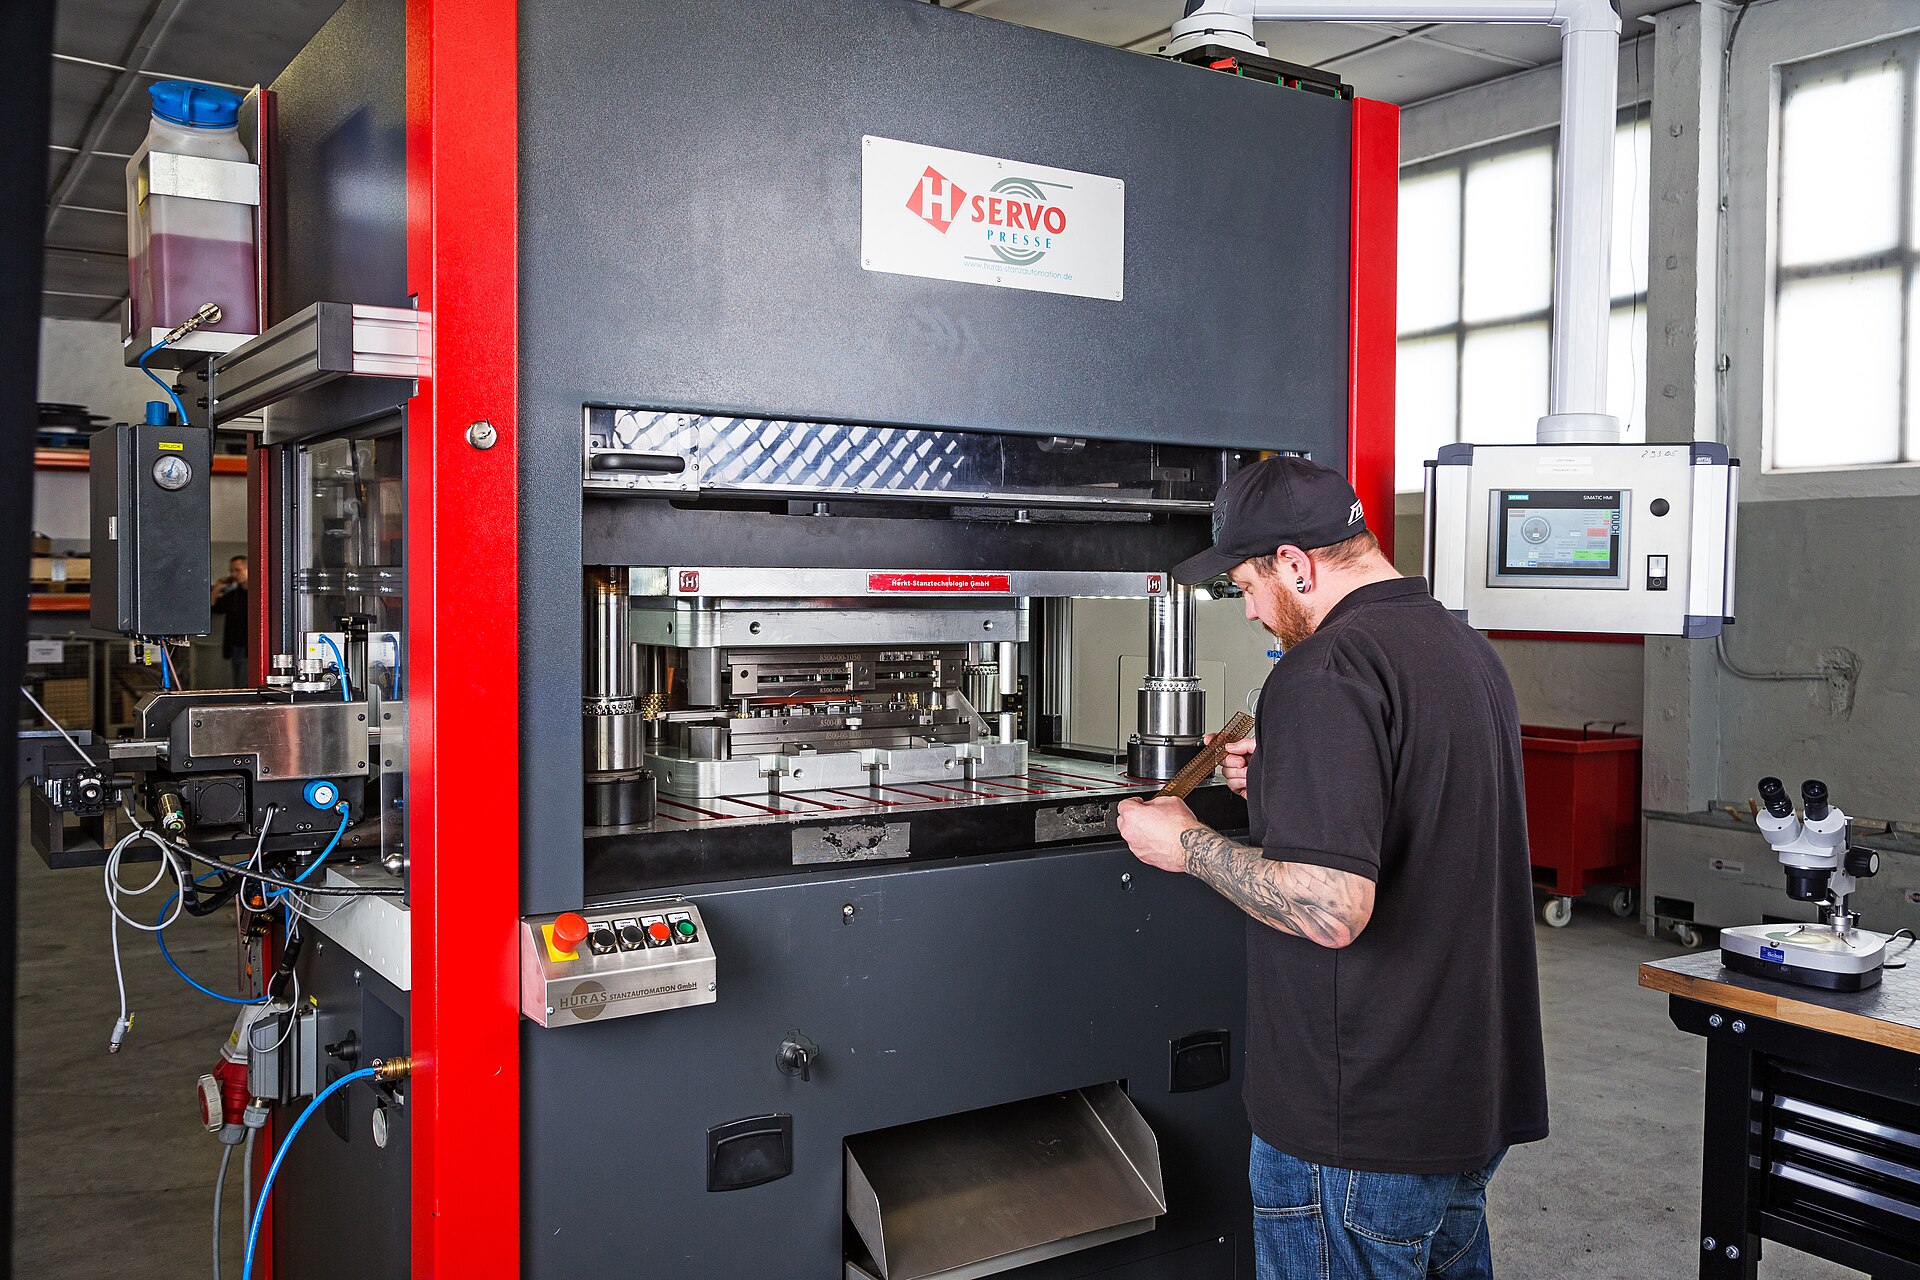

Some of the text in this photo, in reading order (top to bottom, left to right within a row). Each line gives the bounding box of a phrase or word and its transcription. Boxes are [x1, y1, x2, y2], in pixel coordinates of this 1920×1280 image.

[971, 195, 1067, 234] SERVO
[987, 229, 1052, 249] PRESSE
[963, 260, 1073, 281] www.huras-stanzautomation.de
[1612, 509, 1621, 534] TOUCH
[970, 579, 990, 588] GmbH
[560, 982, 697, 1007] HURAS STANZAUTOMATION GmbH
